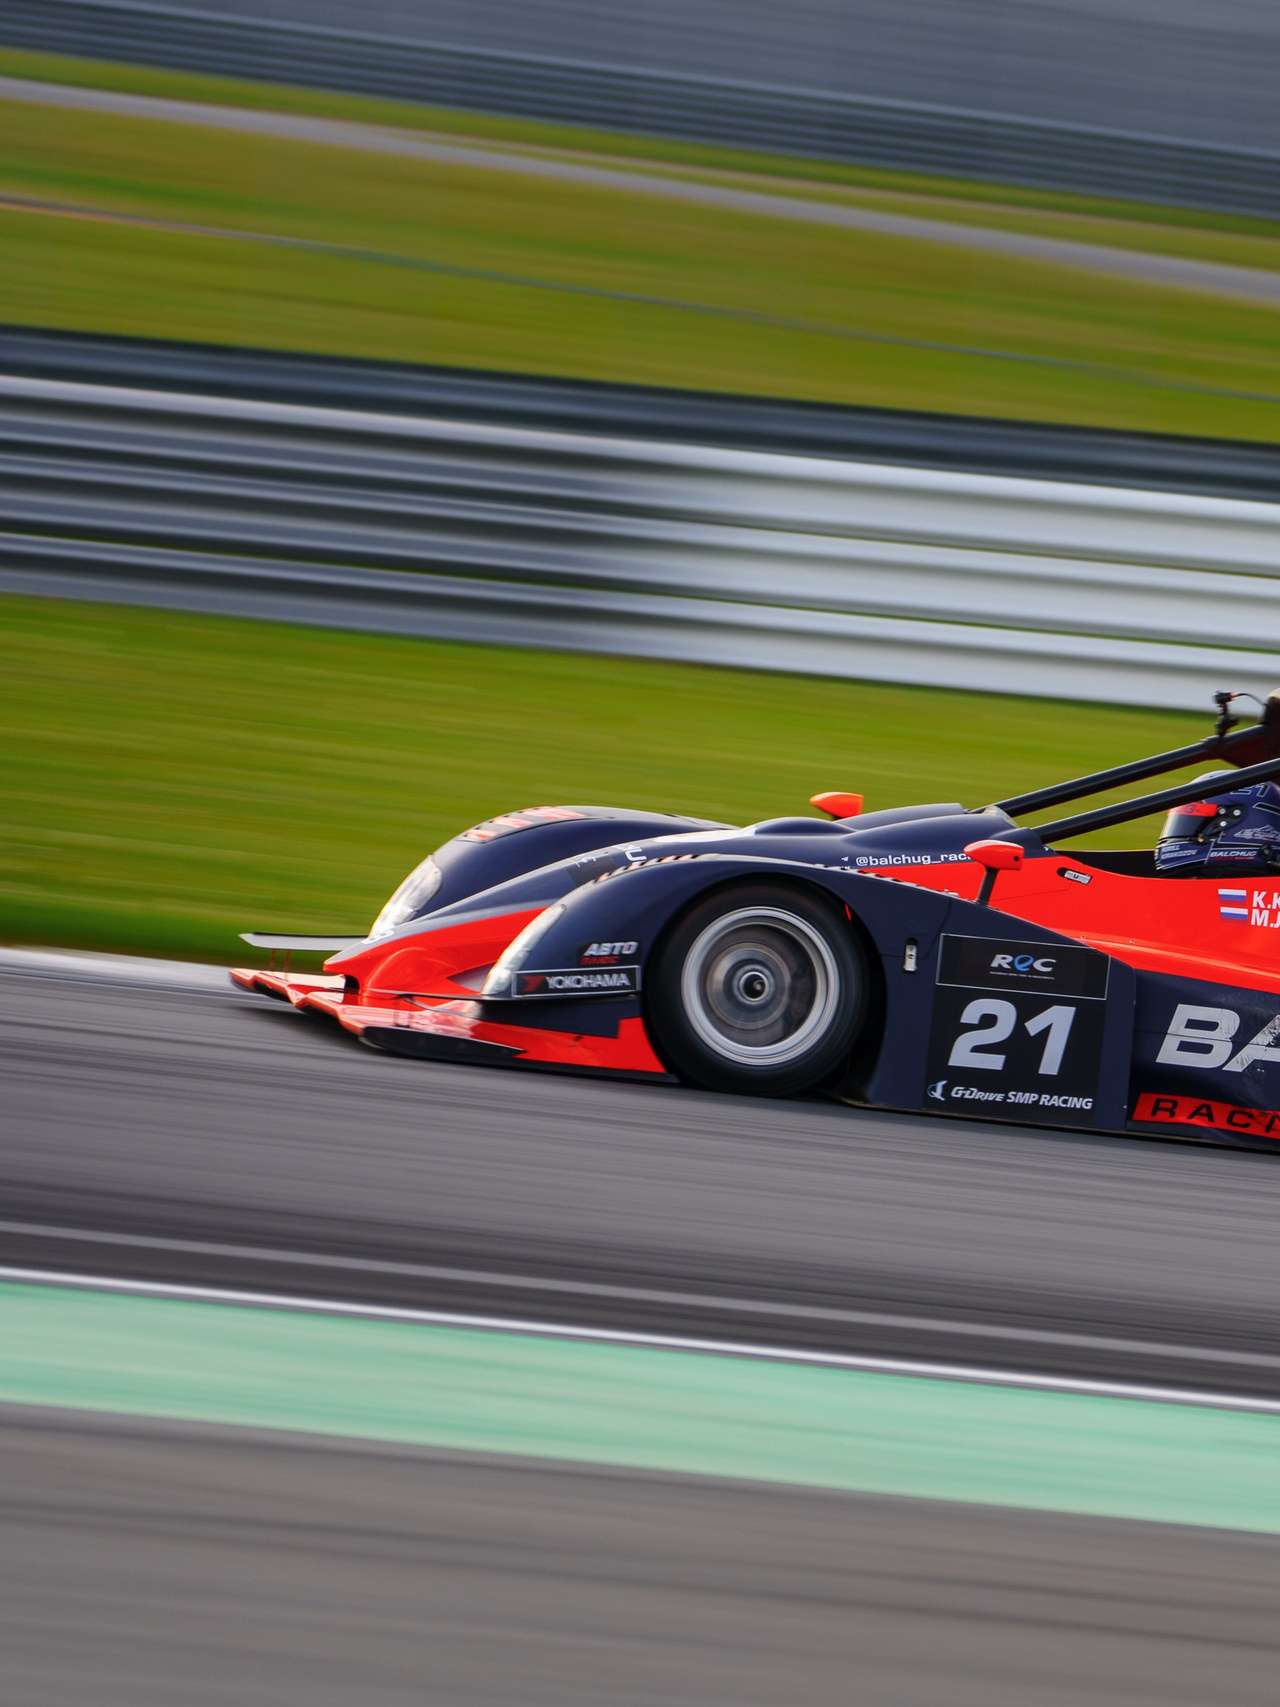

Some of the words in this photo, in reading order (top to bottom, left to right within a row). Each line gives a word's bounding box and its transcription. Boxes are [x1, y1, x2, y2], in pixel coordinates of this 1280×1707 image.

[856, 853, 971, 866] @balchug_rac
[545, 973, 631, 989] YOKOHAMA
[948, 998, 1076, 1075] 21
[1006, 1091, 1039, 1105] SMP
[1039, 1096, 1093, 1110] RACING
